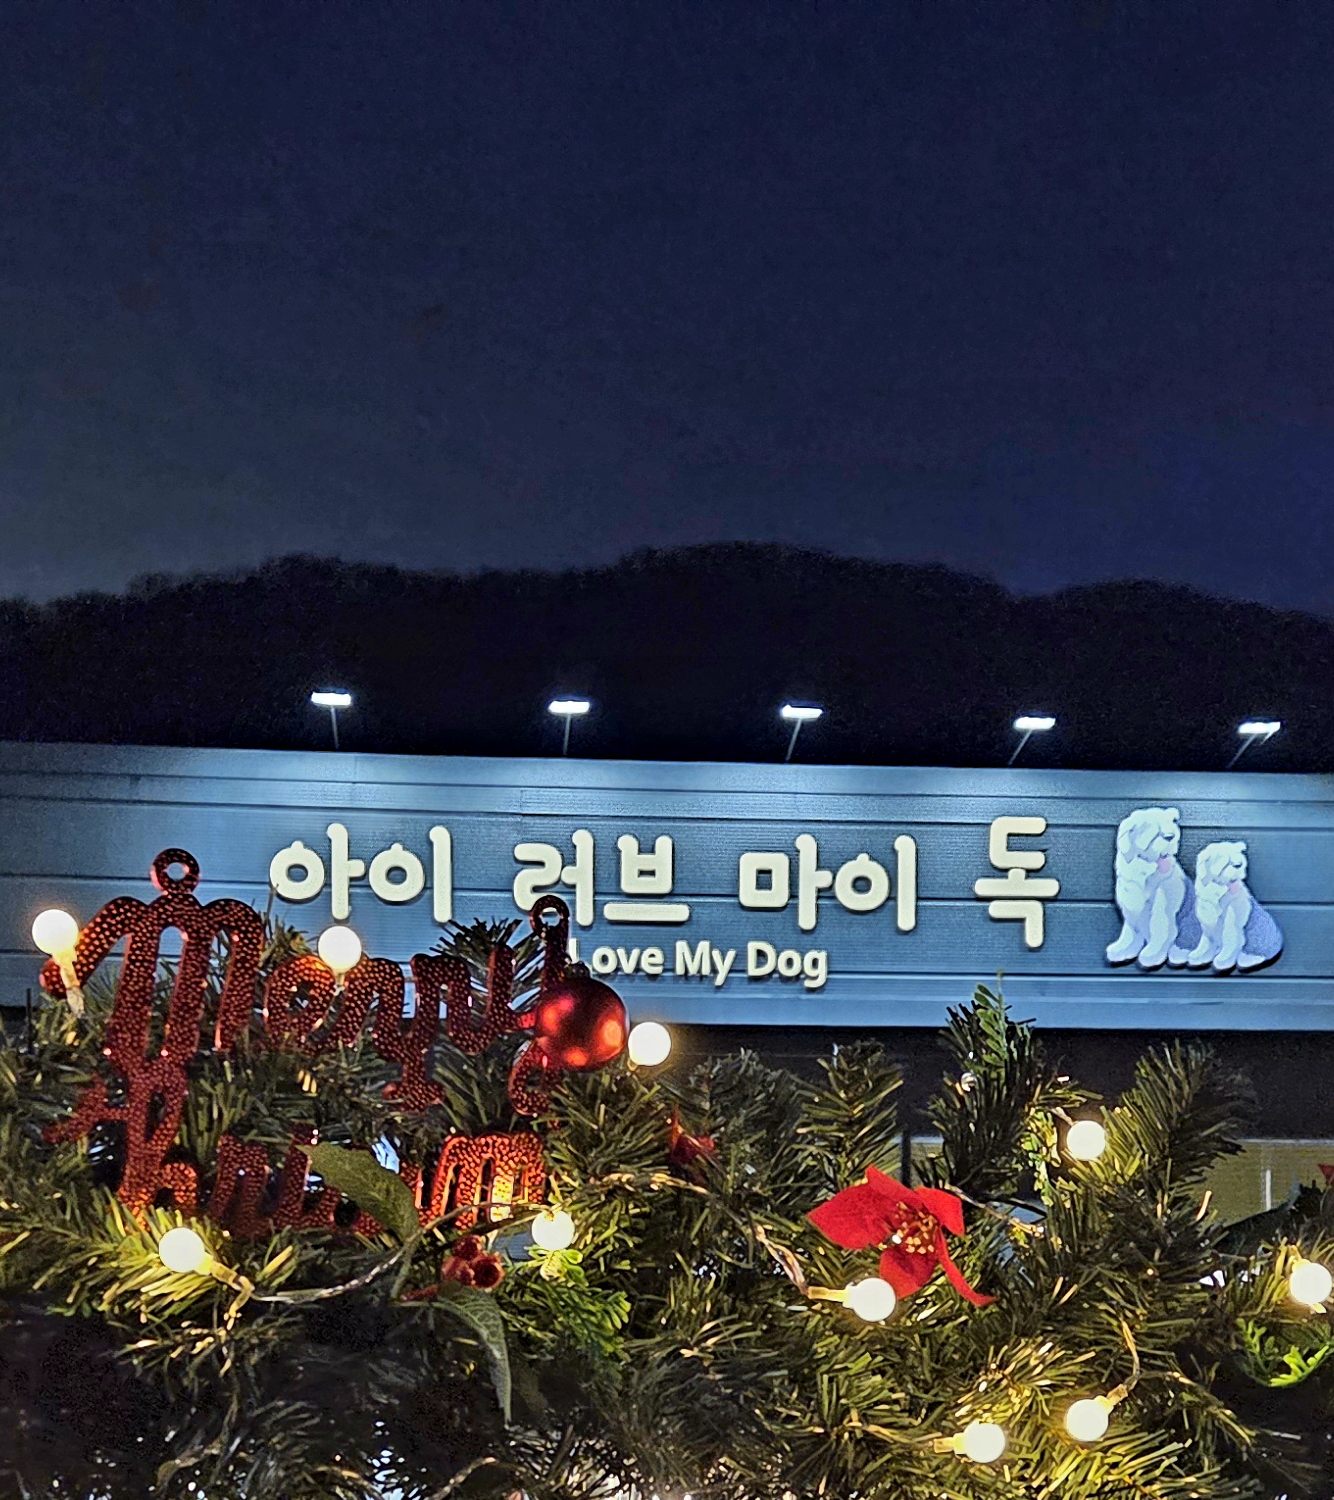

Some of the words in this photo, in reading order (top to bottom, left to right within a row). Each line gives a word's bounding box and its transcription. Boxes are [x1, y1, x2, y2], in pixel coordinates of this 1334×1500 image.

[268, 821, 453, 925] 아이
[512, 829, 692, 928] 러브
[738, 833, 917, 932] 마이
[973, 815, 1061, 949] 독
[675, 939, 737, 988] My
[747, 940, 829, 989] Dog
